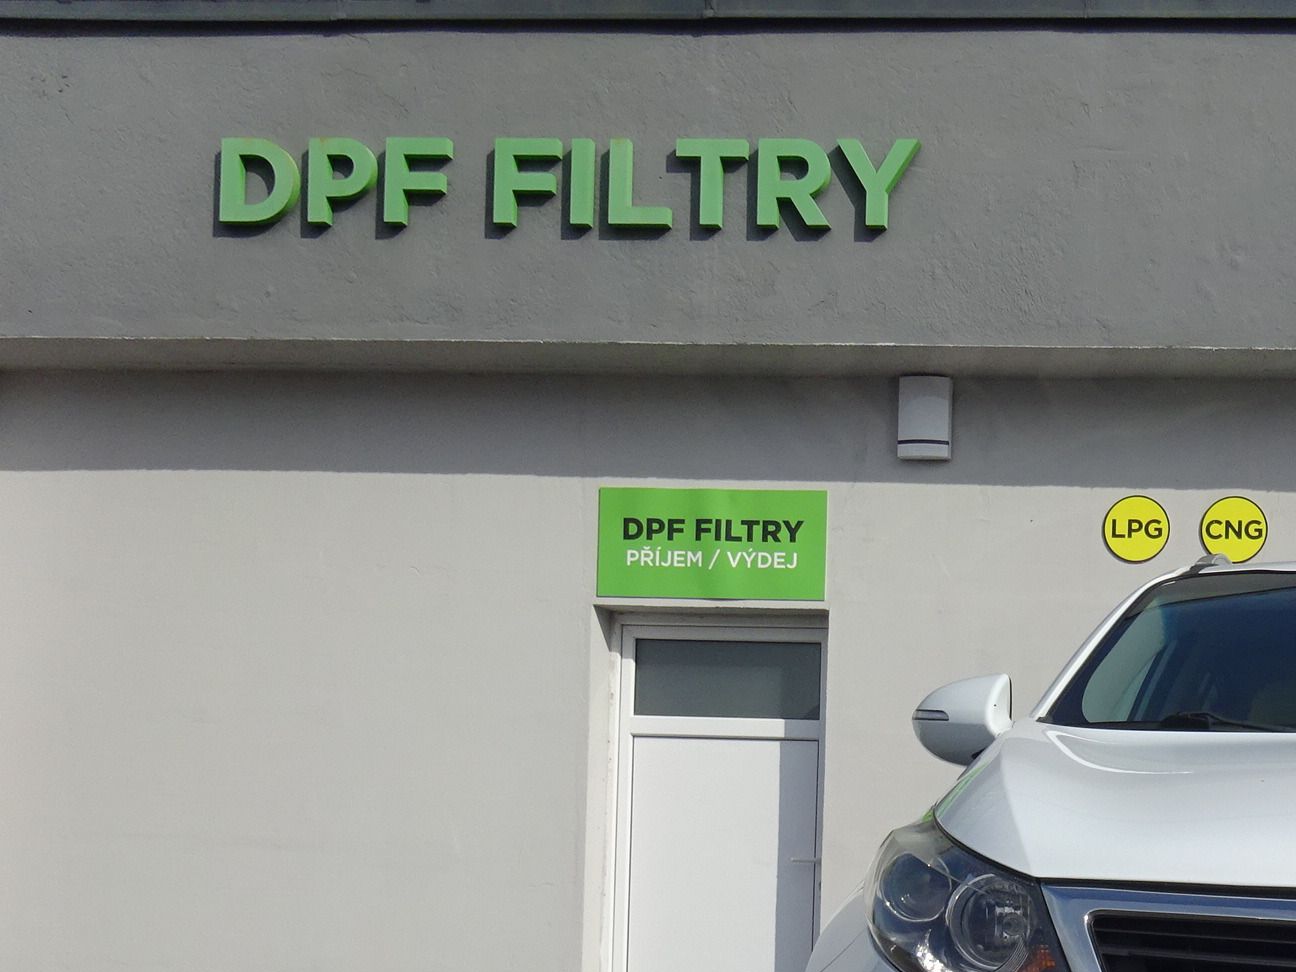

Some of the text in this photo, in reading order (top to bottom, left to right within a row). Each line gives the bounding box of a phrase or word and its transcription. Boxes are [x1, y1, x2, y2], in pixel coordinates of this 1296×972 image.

[218, 137, 923, 230] DPF FILTRY
[622, 517, 805, 543] DPF FILTRY
[1111, 518, 1163, 540] LPG
[1204, 518, 1264, 541] CNG
[626, 546, 798, 570] PŘÍJEM / VÝDEJ
